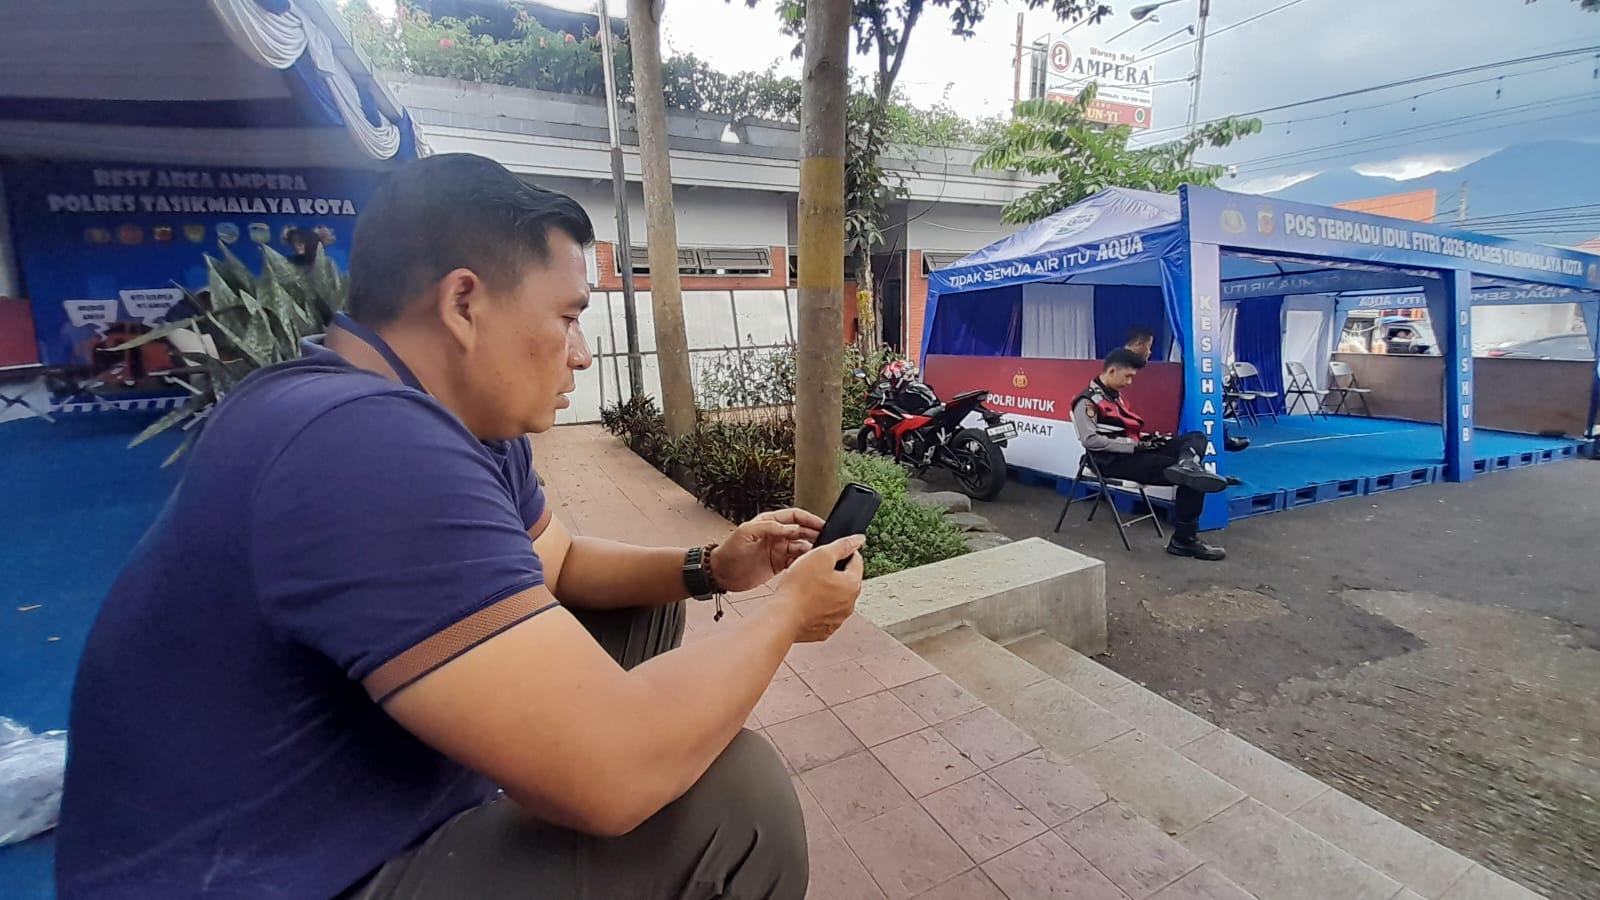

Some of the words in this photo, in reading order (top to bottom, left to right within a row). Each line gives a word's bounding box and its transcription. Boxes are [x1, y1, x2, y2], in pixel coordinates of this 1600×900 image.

[1072, 57, 1149, 85] AMPERA
[93, 169, 149, 186] REST
[156, 170, 213, 188] AREA
[218, 173, 307, 191] AMPERA
[48, 194, 136, 212] POLRES
[139, 196, 295, 214] TASIKMALAYA
[297, 198, 357, 216] KOTA
[949, 270, 982, 288] TIDAK
[984, 265, 1031, 282] SEMUA
[1033, 257, 1059, 274] AIR
[1063, 251, 1090, 269] ITU
[1096, 235, 1144, 263] AQUA
[1284, 213, 1316, 237] POS
[1318, 217, 1380, 246] TERPADU
[1382, 227, 1411, 250] IDUL
[1412, 232, 1441, 254] FITRI
[1441, 237, 1466, 258] 2025
[1465, 241, 1501, 264] POLRES
[1501, 248, 1562, 273] TASIKMALAYA
[1562, 258, 1583, 276] KOTA
[1199, 295, 1218, 475] KESEHATAN
[1459, 310, 1471, 442] DISHUB
[986, 393, 1015, 407] POLRI
[1017, 396, 1055, 412] UNTUK
